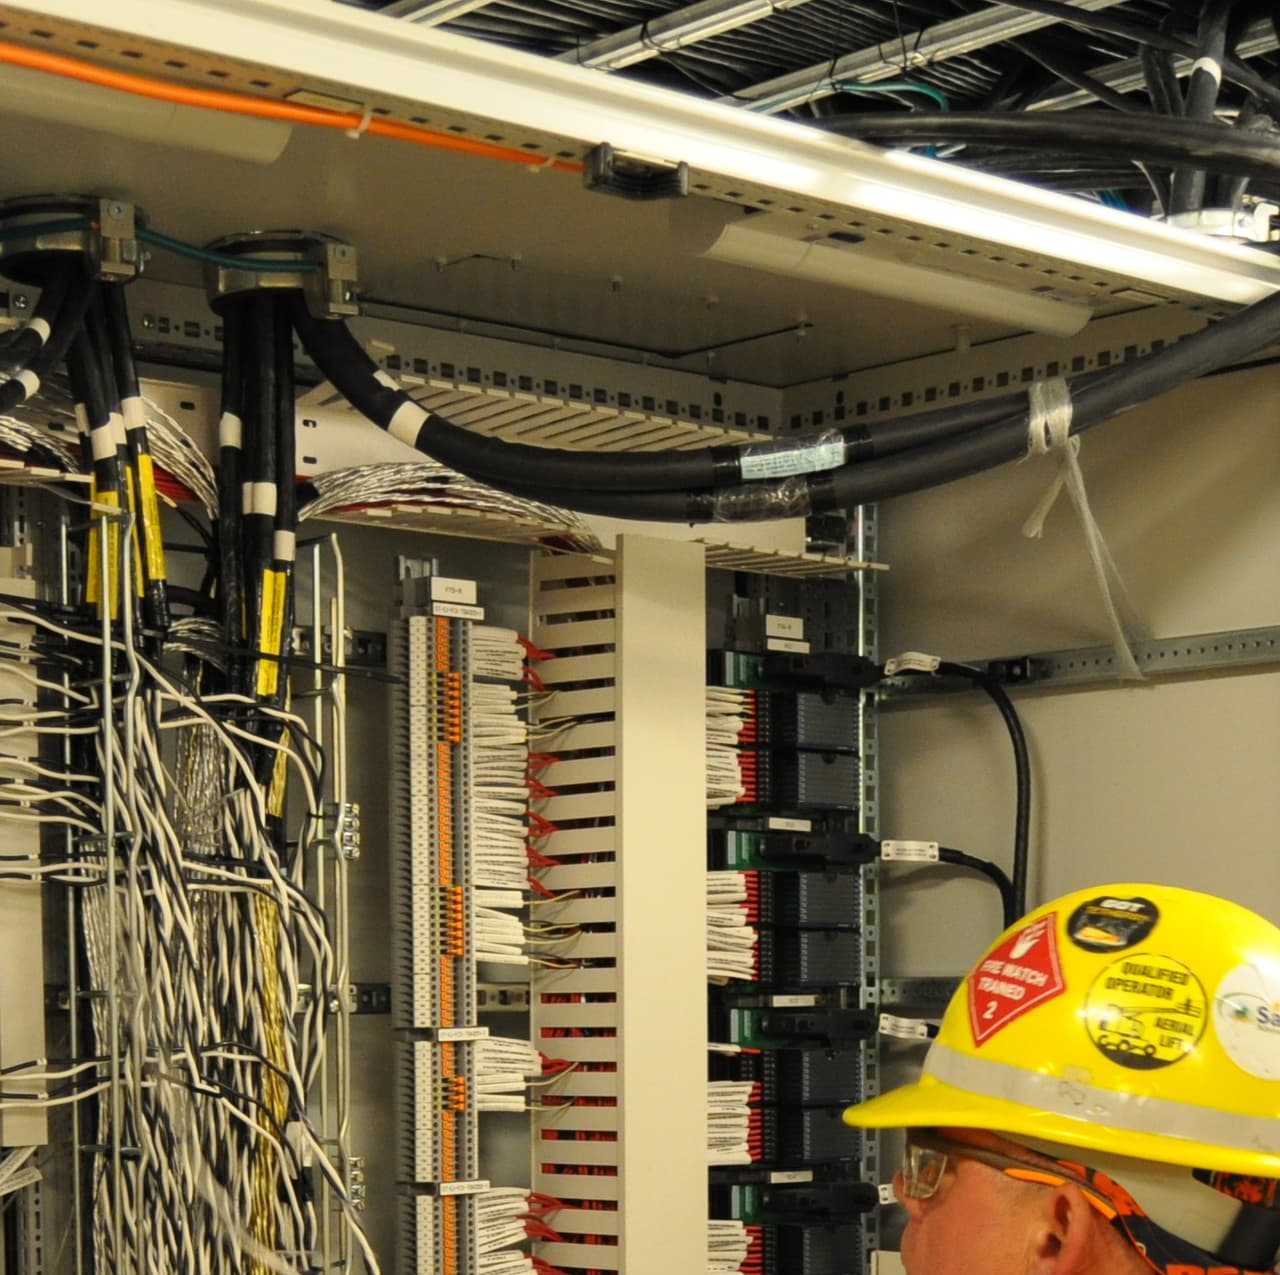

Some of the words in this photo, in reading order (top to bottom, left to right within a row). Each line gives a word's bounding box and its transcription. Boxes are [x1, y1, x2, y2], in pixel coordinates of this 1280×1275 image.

[1002, 963, 1049, 988] WATCH
[1122, 962, 1190, 987] QUALIFIED
[977, 977, 1026, 1001] TRAINED
[1105, 976, 1174, 1001] OPERATOR
[983, 1001, 998, 1020] 2
[1155, 1017, 1194, 1036] AERIAL
